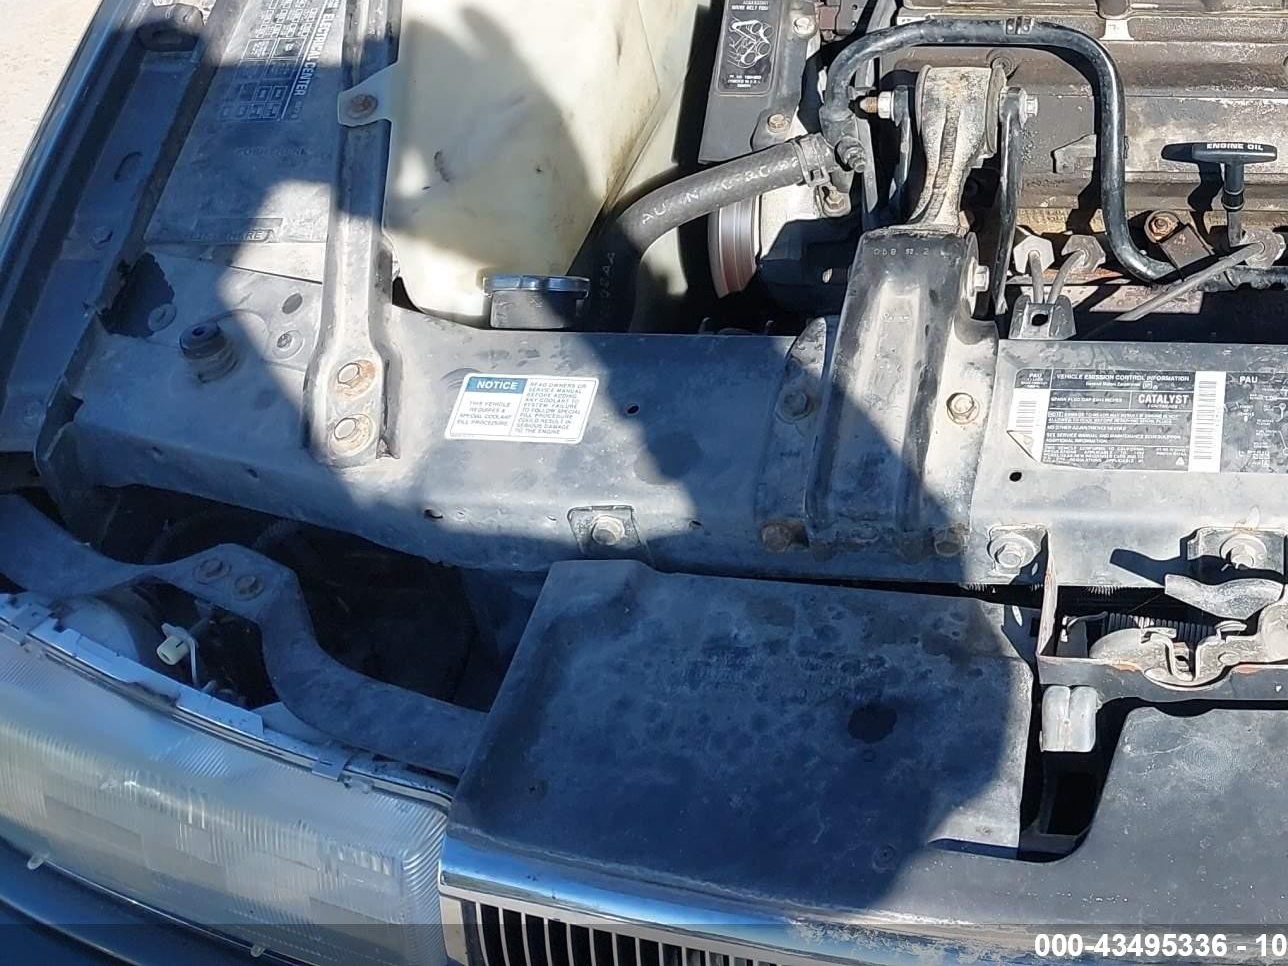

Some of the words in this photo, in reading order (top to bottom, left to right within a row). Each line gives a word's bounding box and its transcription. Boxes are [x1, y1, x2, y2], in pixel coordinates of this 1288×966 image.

[307, 13, 335, 61] ELECTRICAL
[293, 62, 316, 96] CENTER
[1206, 142, 1244, 150] ENGINE
[1247, 143, 1264, 151] OIL
[476, 380, 519, 390] NOTICE
[1138, 394, 1189, 404] CATALYST
